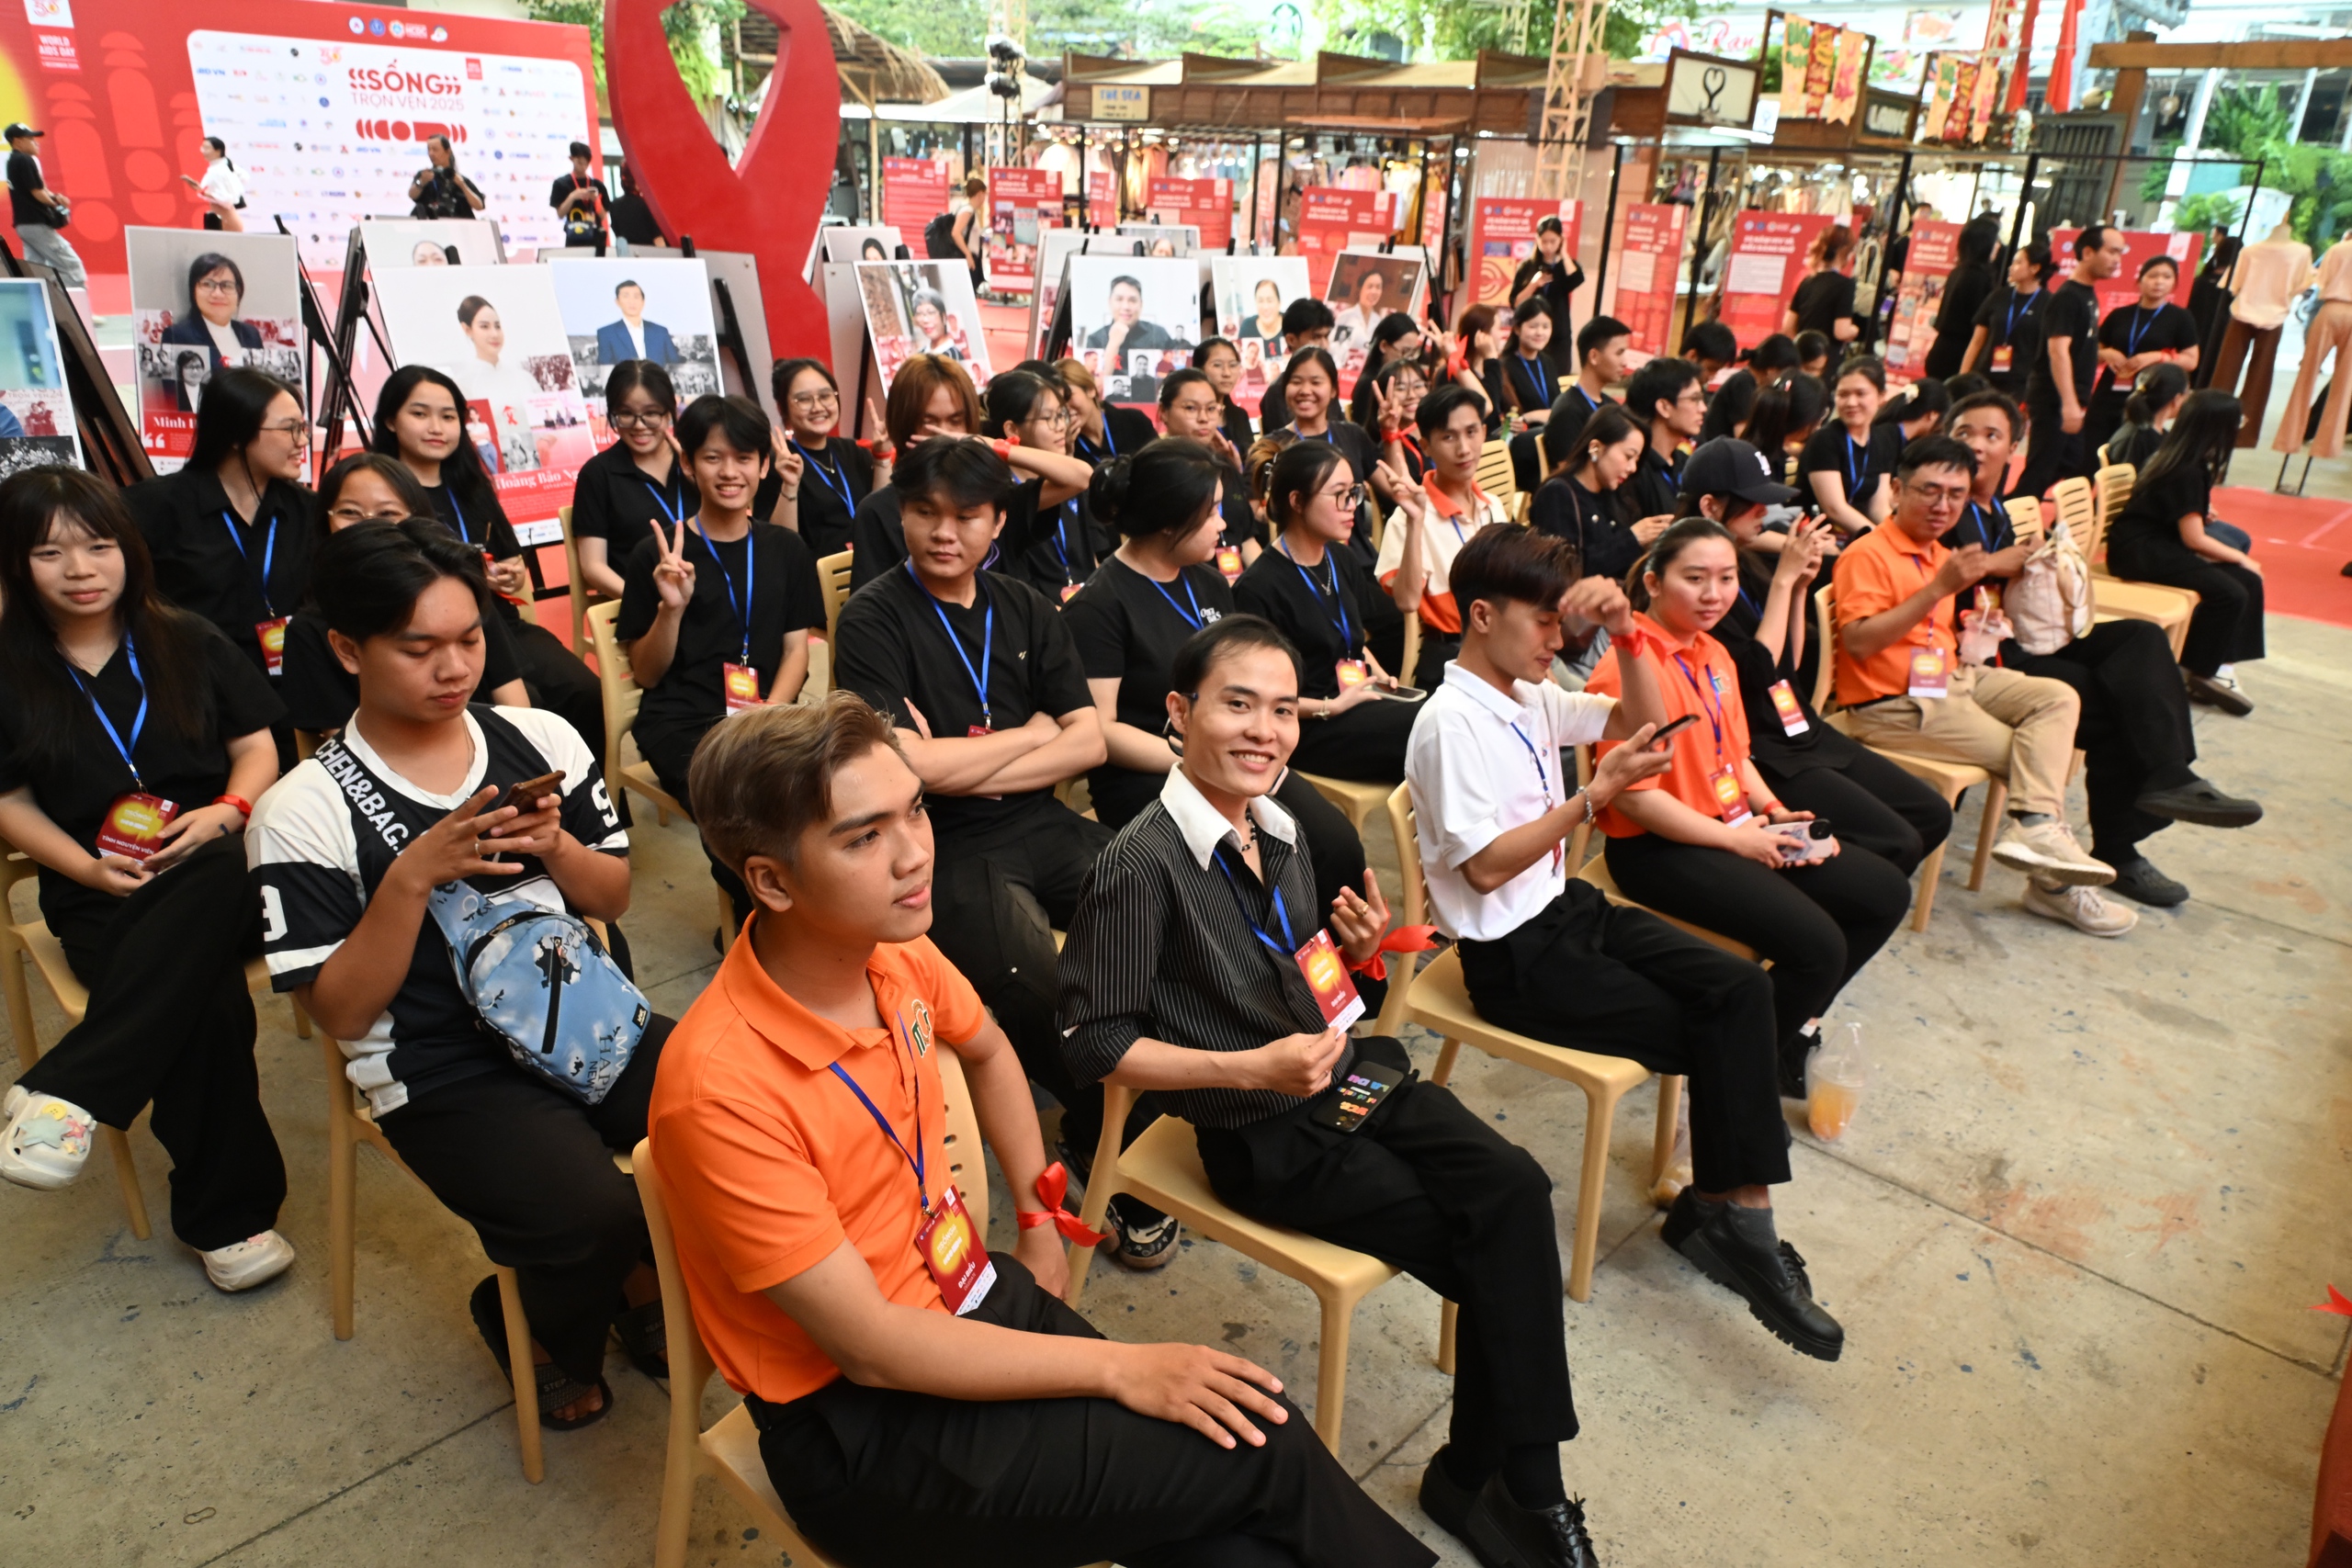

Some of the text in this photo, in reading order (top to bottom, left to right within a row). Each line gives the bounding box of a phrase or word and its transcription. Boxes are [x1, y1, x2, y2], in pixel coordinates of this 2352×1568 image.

[368, 59, 446, 95] SỐNG
[352, 92, 393, 108] TRỌN
[430, 96, 465, 111] 2025
[153, 416, 187, 429] Minh
